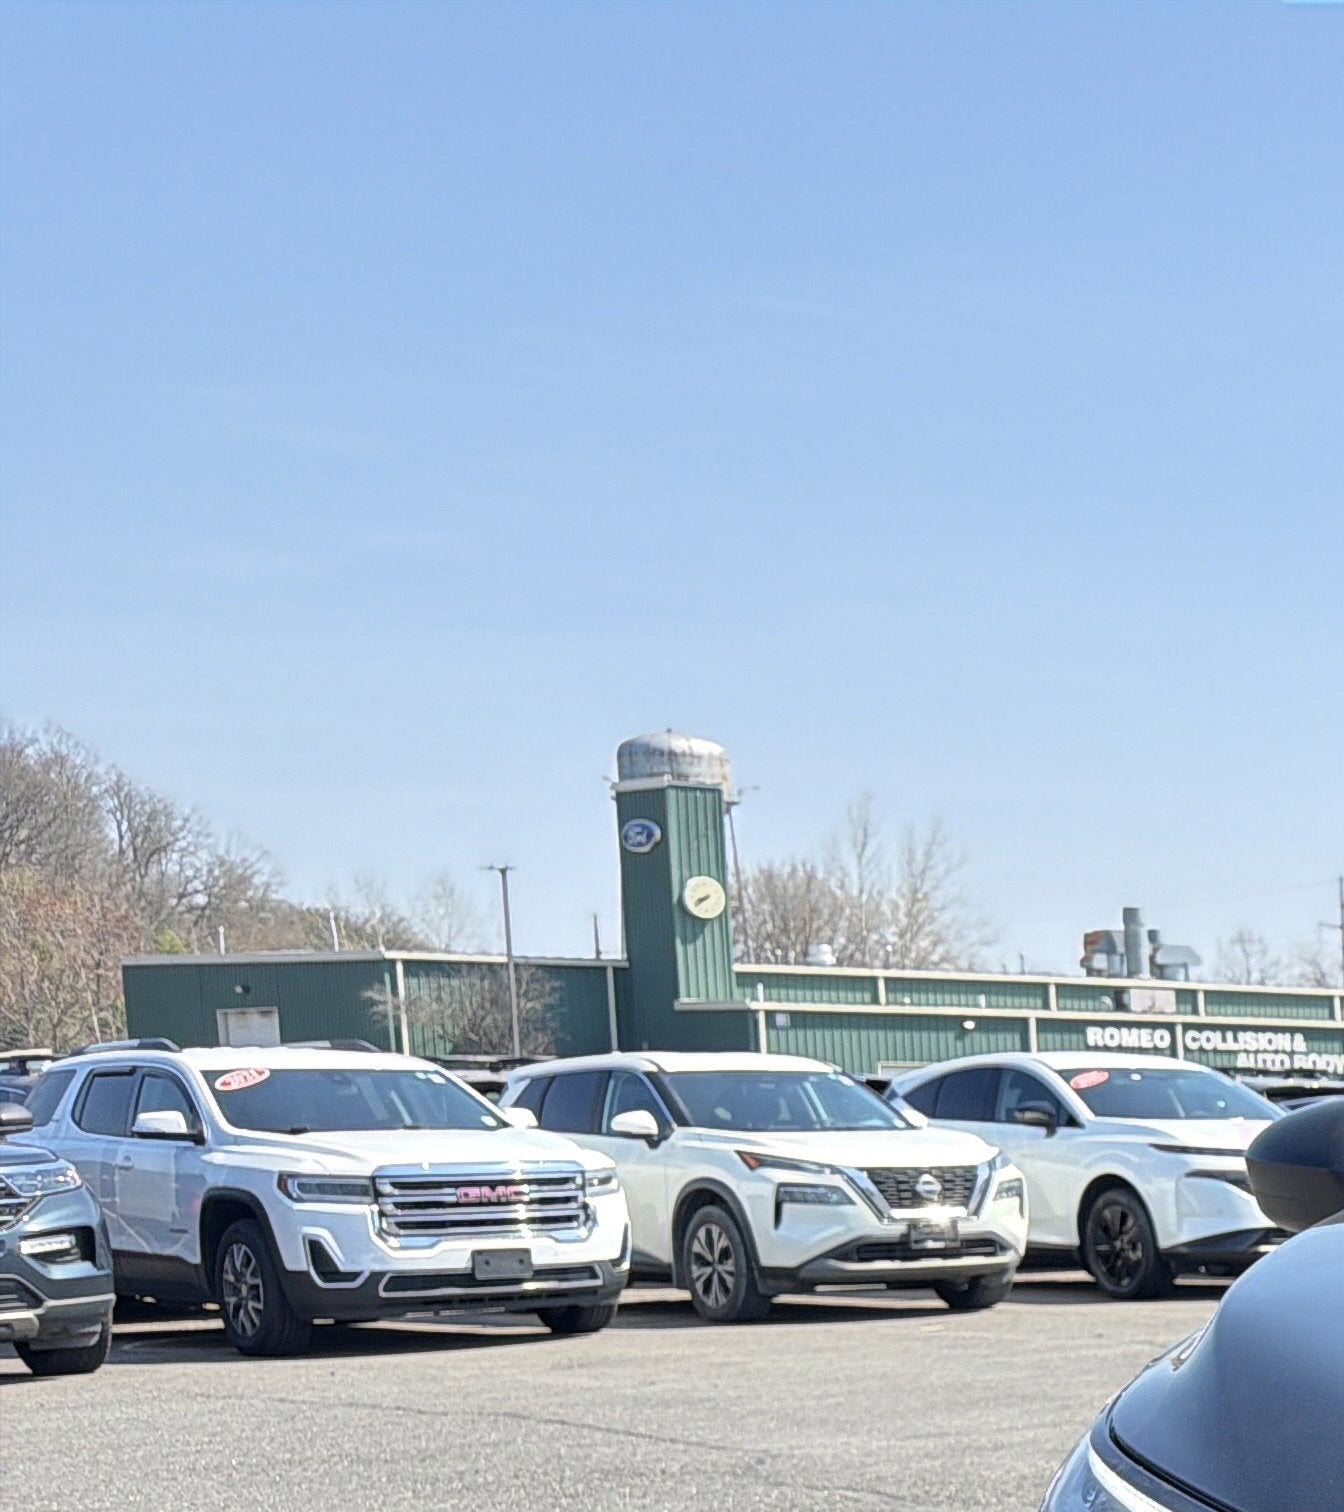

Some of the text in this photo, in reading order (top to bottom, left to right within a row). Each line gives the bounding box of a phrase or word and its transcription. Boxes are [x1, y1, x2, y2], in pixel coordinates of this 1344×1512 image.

[1086, 1026, 1171, 1049] ROMEO
[1184, 1030, 1291, 1051] COLLISION
[1237, 1052, 1291, 1070] AUTO
[456, 1185, 529, 1203] GMC
